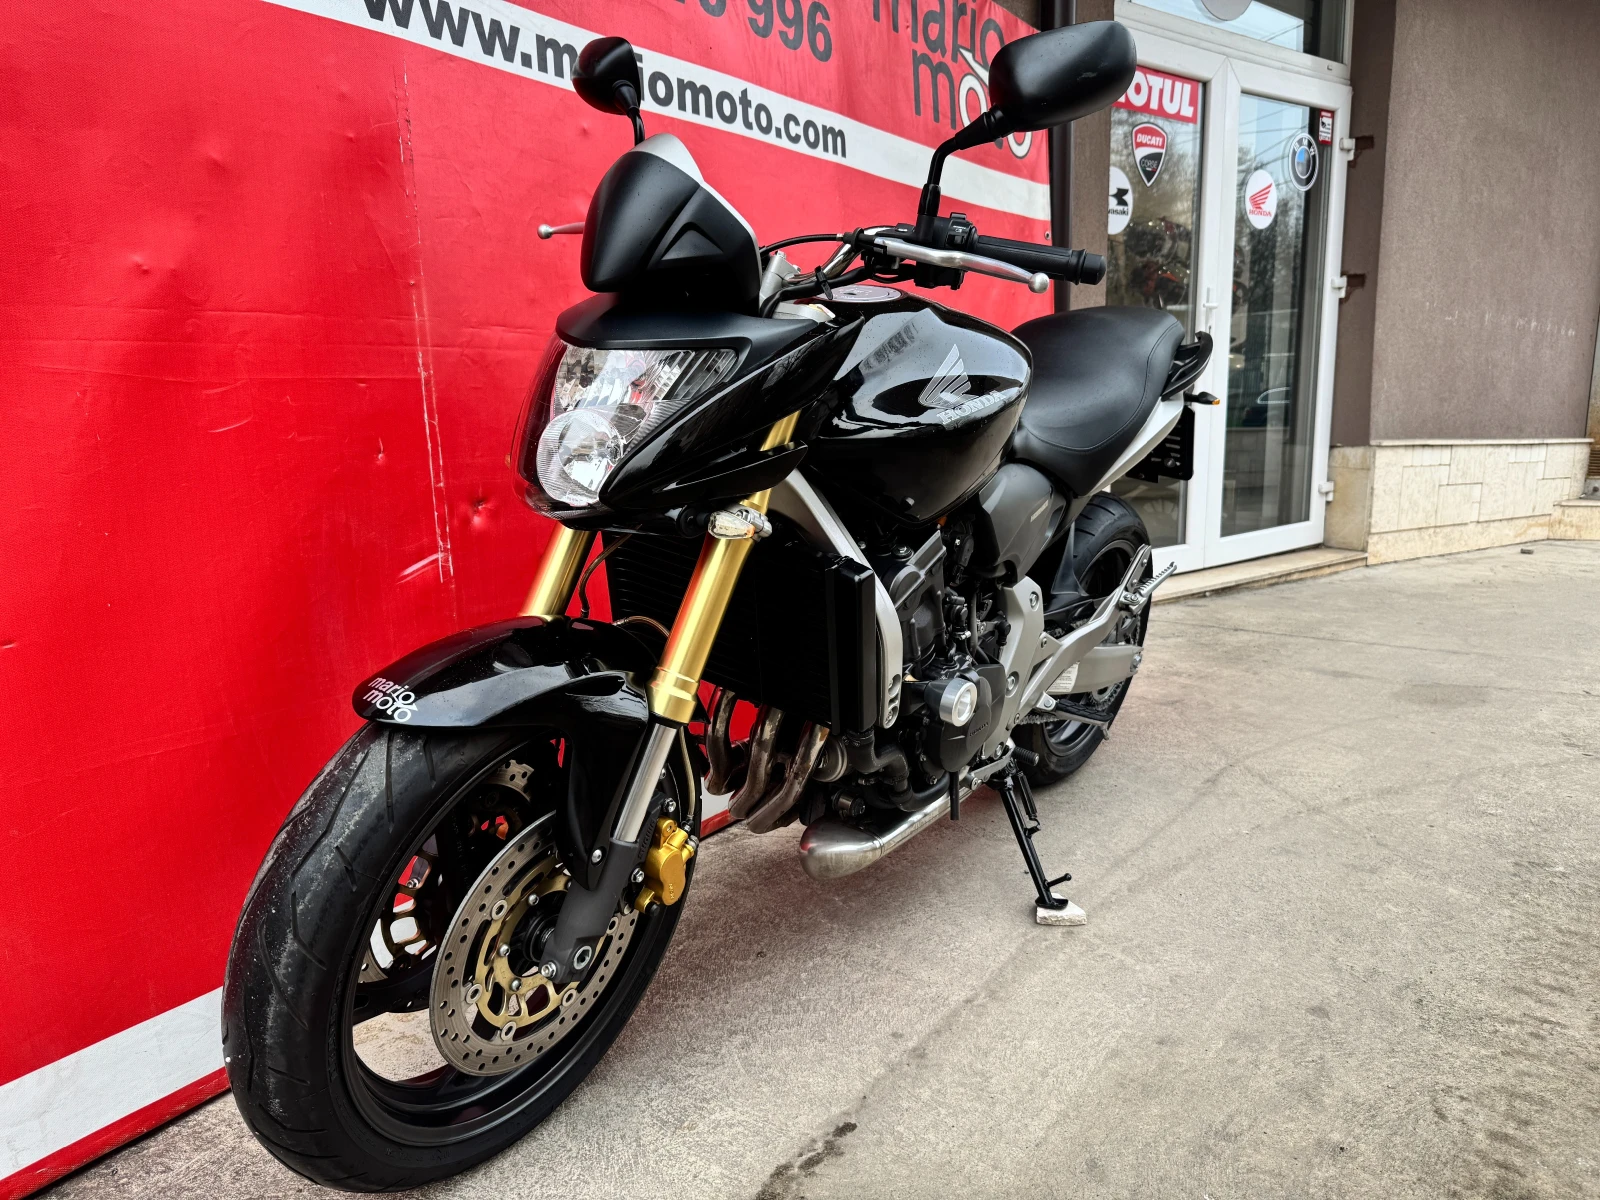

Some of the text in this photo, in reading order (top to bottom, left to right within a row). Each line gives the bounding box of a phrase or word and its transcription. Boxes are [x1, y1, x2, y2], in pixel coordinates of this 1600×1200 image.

[747, 0, 832, 62] 996
[363, 0, 847, 159] www.miomoto.com
[1117, 70, 1194, 118] OTUL
[911, 48, 1033, 159] mo
[1136, 133, 1163, 147] DUCATI
[1140, 158, 1159, 169] CORSE
[1248, 209, 1272, 217] HONDA
[936, 390, 1007, 425] HONDA
[362, 689, 412, 723] moto
[367, 677, 416, 705] mario
